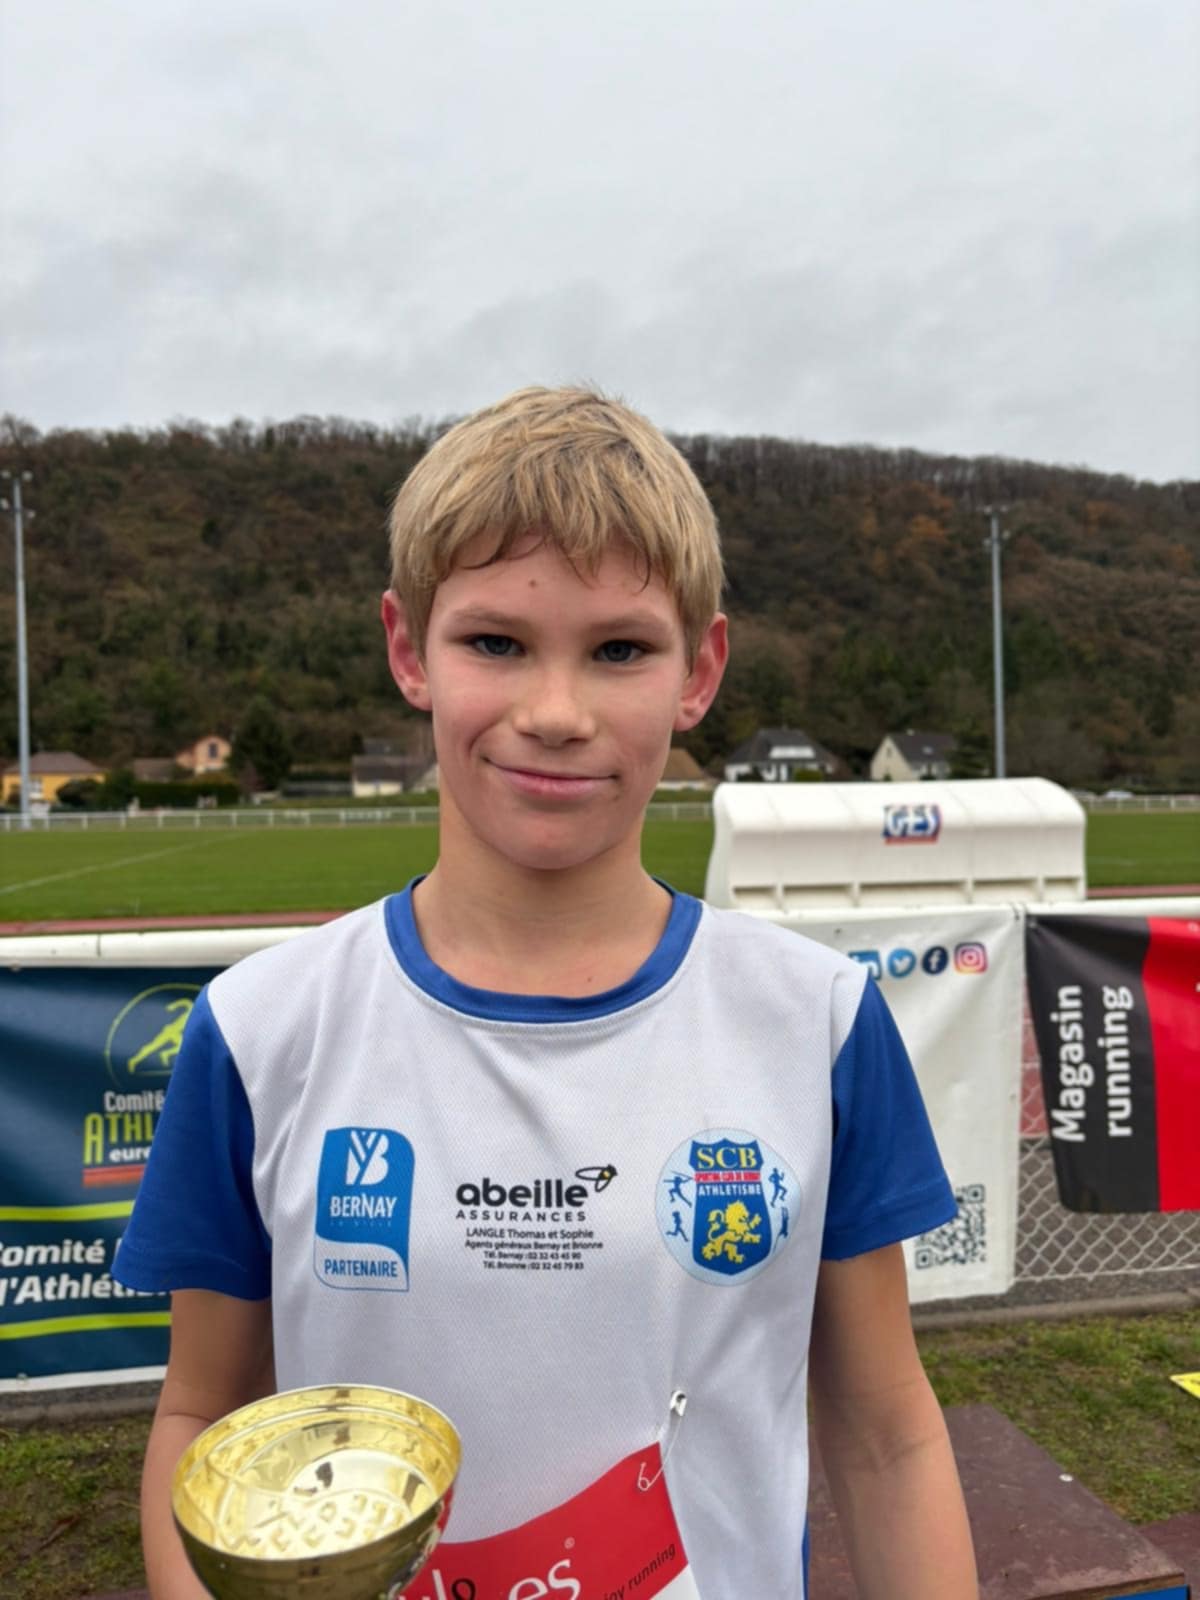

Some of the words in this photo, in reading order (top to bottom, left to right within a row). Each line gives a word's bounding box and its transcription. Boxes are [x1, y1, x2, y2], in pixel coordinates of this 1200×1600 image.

[1050, 985, 1094, 1142] Magasin
[1097, 985, 1134, 1137] running
[697, 1147, 757, 1168] SCB
[456, 1177, 588, 1208] abeille
[698, 1184, 761, 1196] ATHLETISME
[330, 1193, 397, 1218] BERNAY
[456, 1209, 587, 1222] ASSURANCES
[466, 1227, 505, 1238] LANGLE
[507, 1228, 546, 1239] Thomas
[548, 1231, 557, 1239] et
[560, 1229, 593, 1241] Sophie
[0, 1239, 105, 1267] omité
[465, 1240, 493, 1250] Agents
[495, 1241, 532, 1250] généraux
[534, 1241, 560, 1251] Bernay
[572, 1241, 603, 1250] Brionne
[497, 1261, 526, 1269] Brionne
[498, 1251, 523, 1261] Bernay
[324, 1258, 398, 1278] PARTENAIRE
[628, 1543, 677, 1591] running
